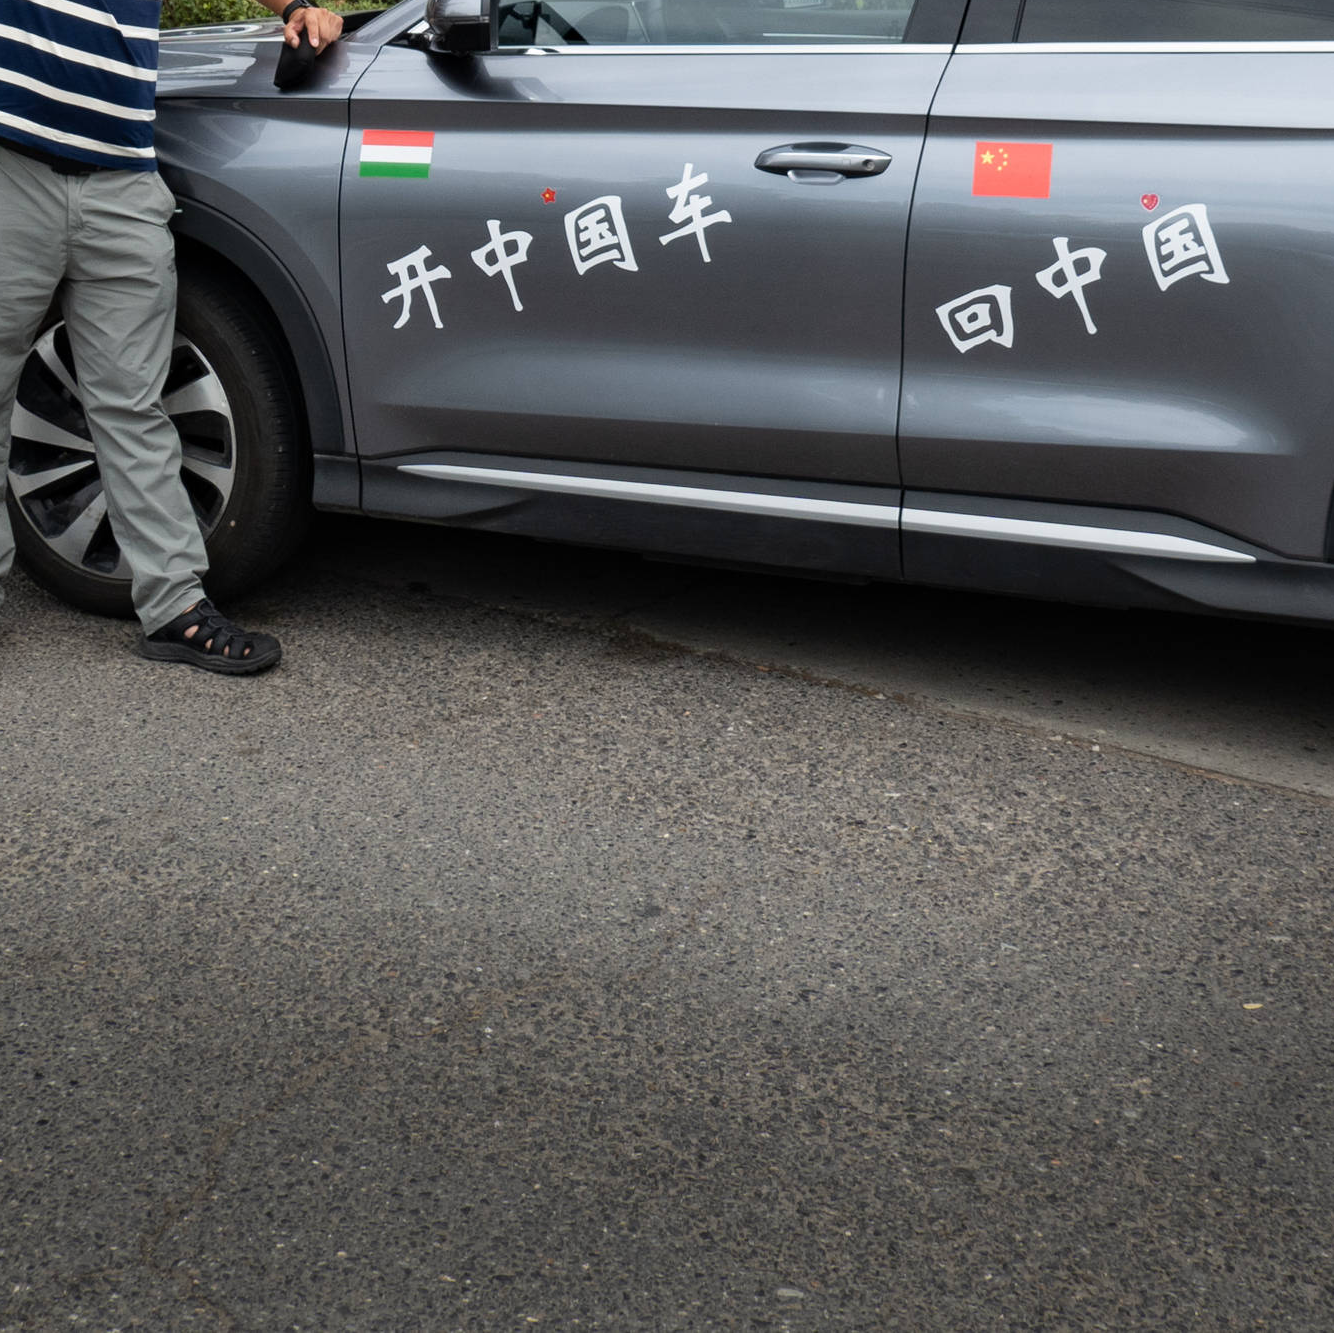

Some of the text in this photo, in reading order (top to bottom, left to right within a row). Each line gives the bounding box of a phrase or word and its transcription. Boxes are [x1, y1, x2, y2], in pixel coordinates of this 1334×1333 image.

[380, 162, 733, 330] 开中国车
[935, 203, 1231, 354] 回中国
